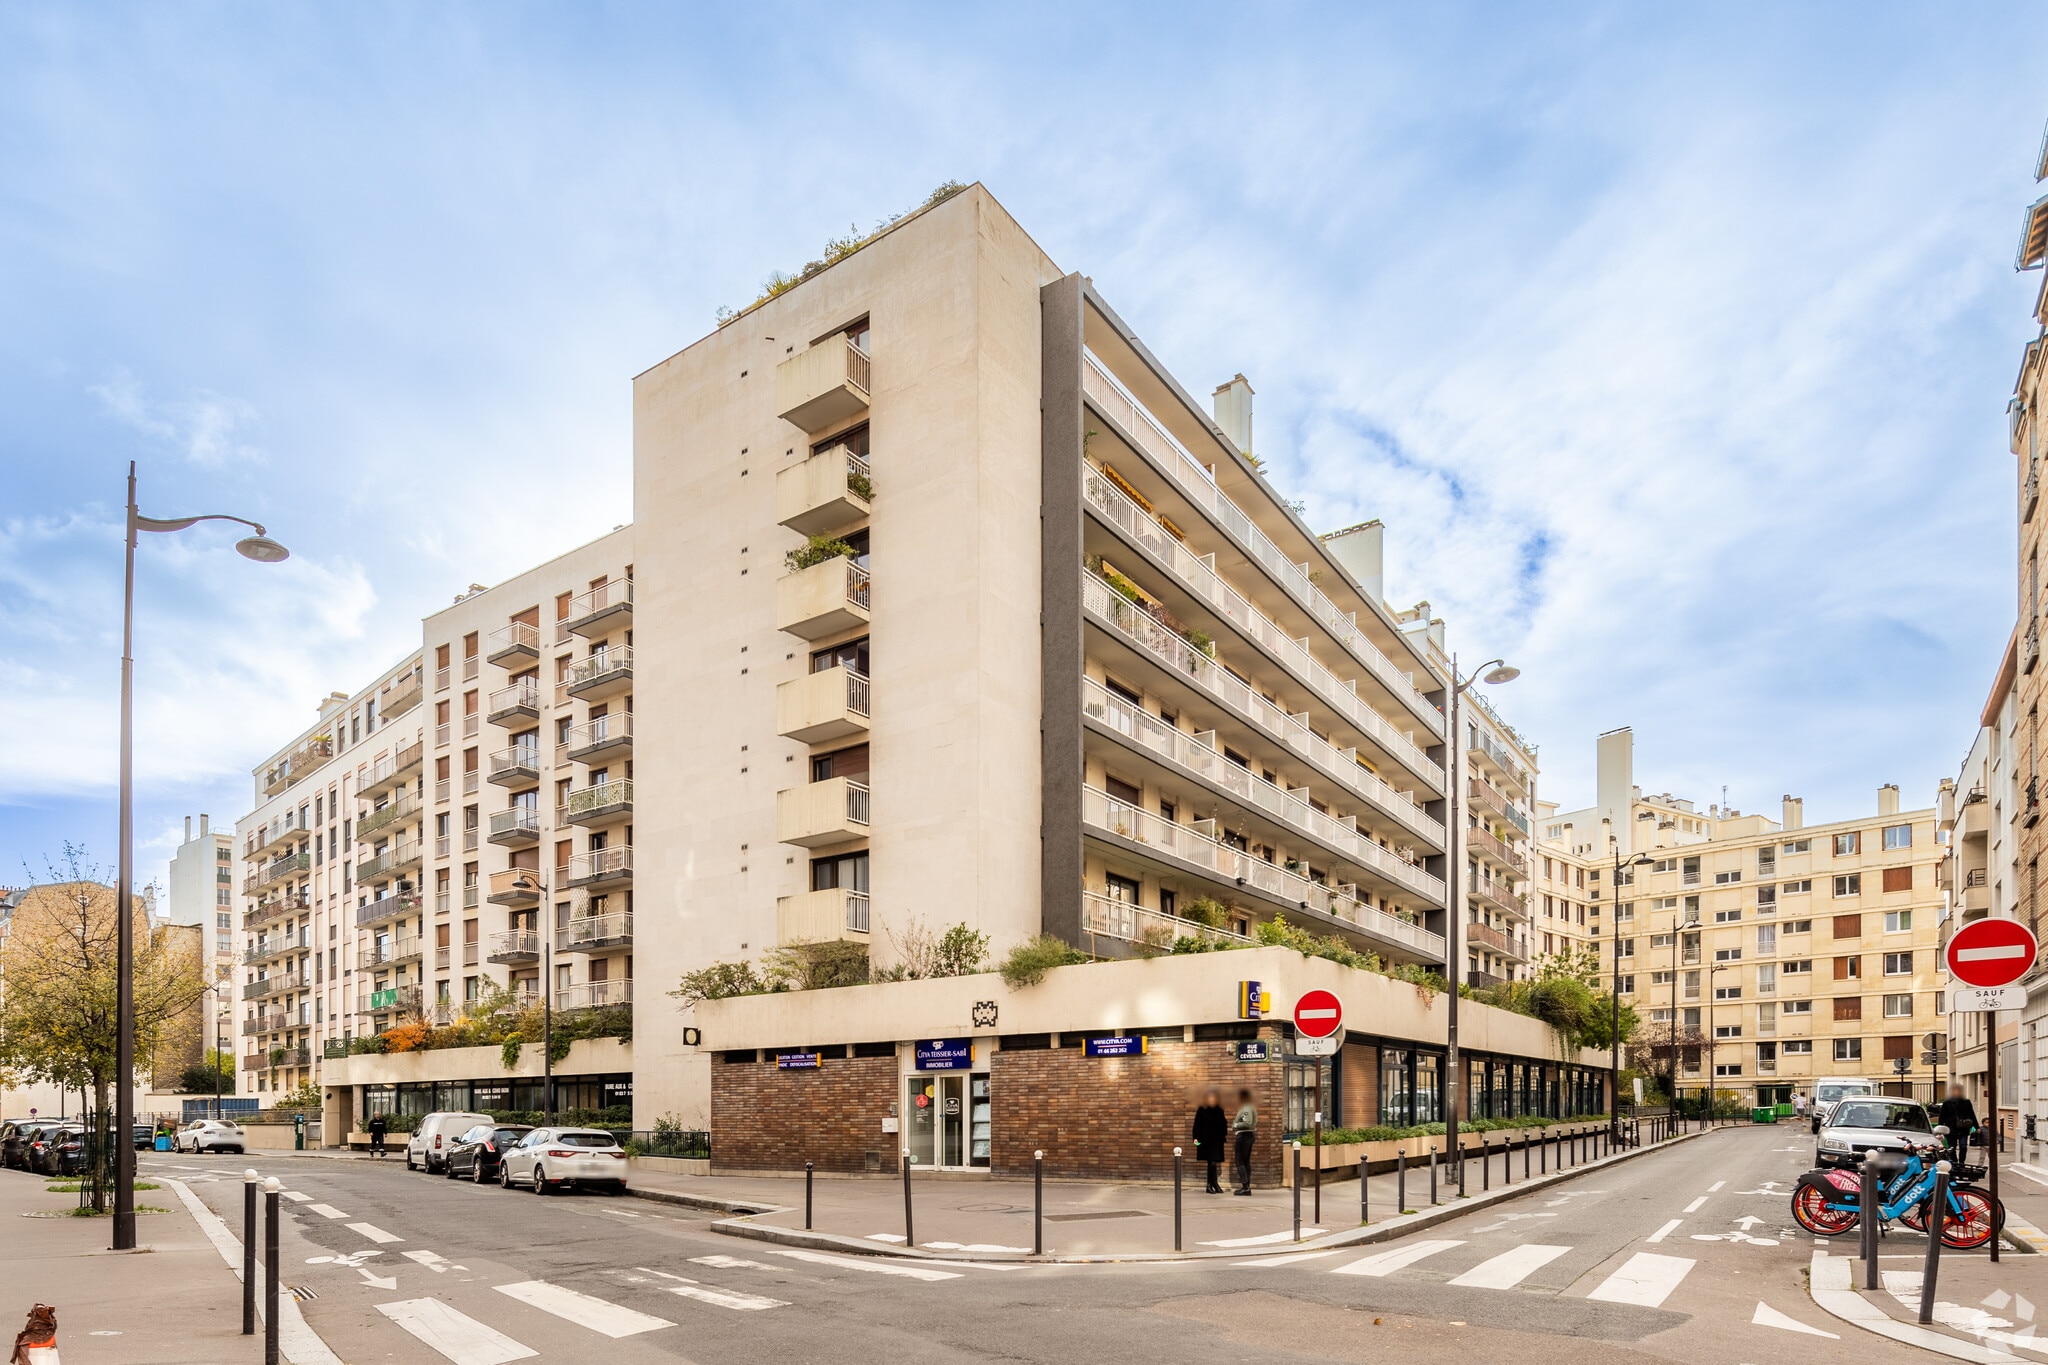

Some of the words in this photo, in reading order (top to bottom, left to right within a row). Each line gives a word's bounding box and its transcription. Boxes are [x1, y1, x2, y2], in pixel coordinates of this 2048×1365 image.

[1975, 989, 2005, 997] SAUF
[1890, 1178, 1906, 1195] dott
[1904, 1185, 1926, 1204] dott
